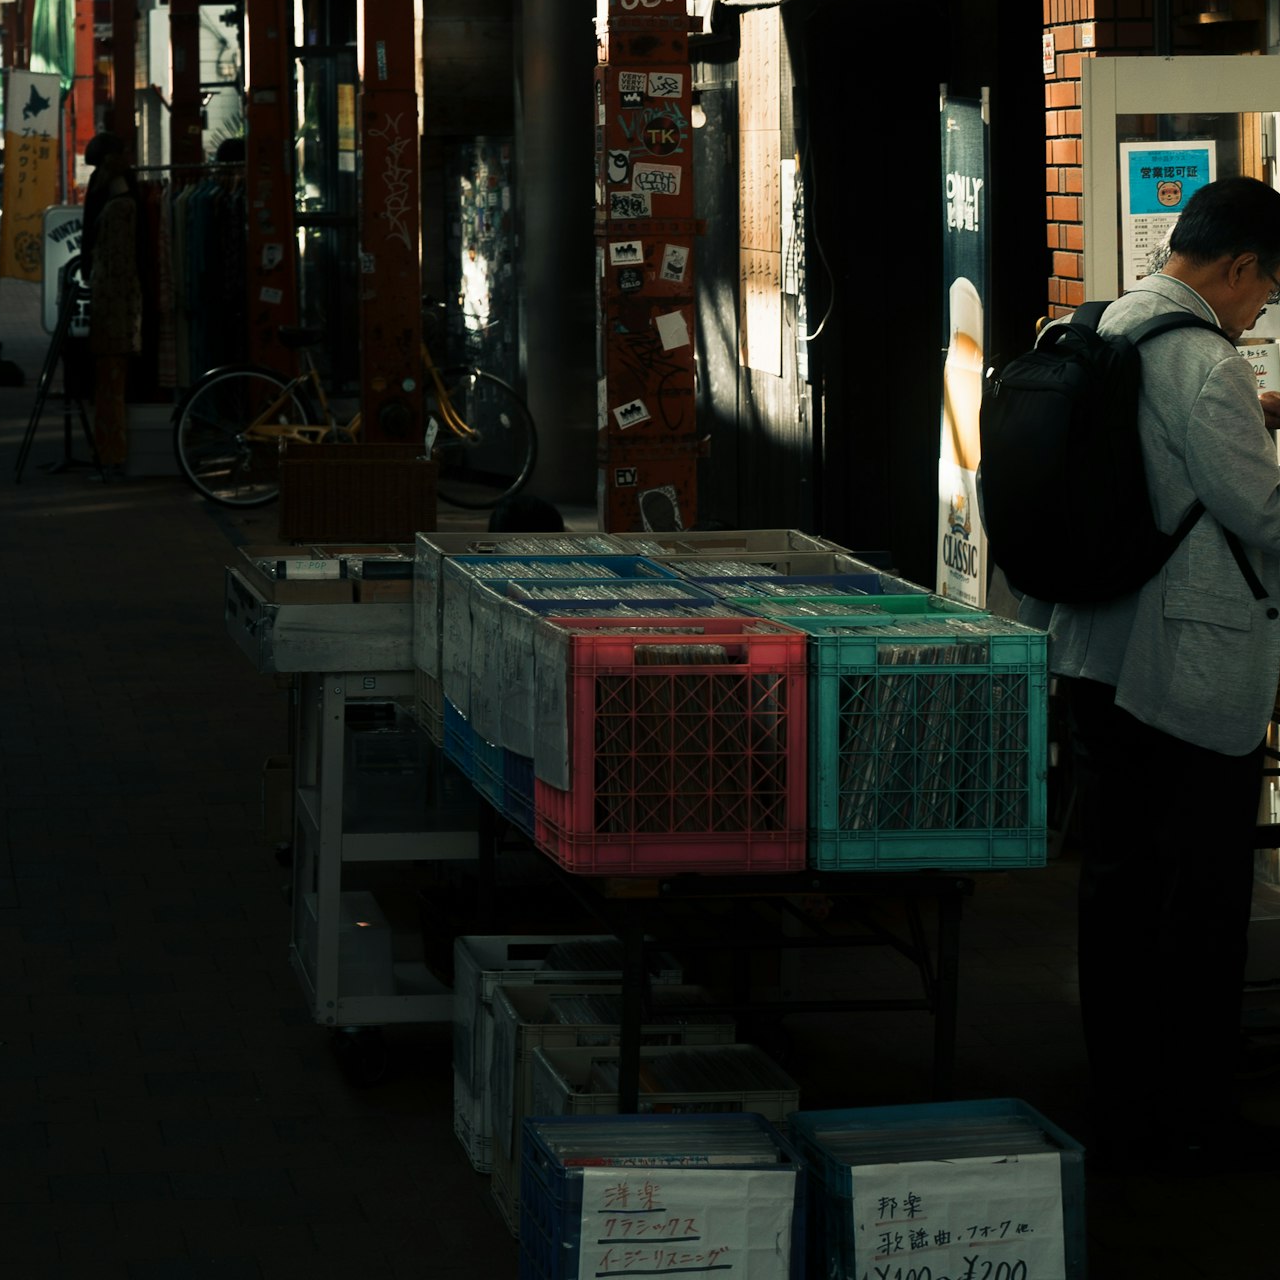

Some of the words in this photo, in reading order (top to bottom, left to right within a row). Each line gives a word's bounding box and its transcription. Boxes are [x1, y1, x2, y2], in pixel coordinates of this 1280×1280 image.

[647, 129, 675, 144] TK
[1140, 165, 1198, 179] 営業認可証
[943, 533, 978, 578] CLASSIC
[604, 1181, 665, 1210] 洋楽
[877, 1191, 923, 1219] 邦楽
